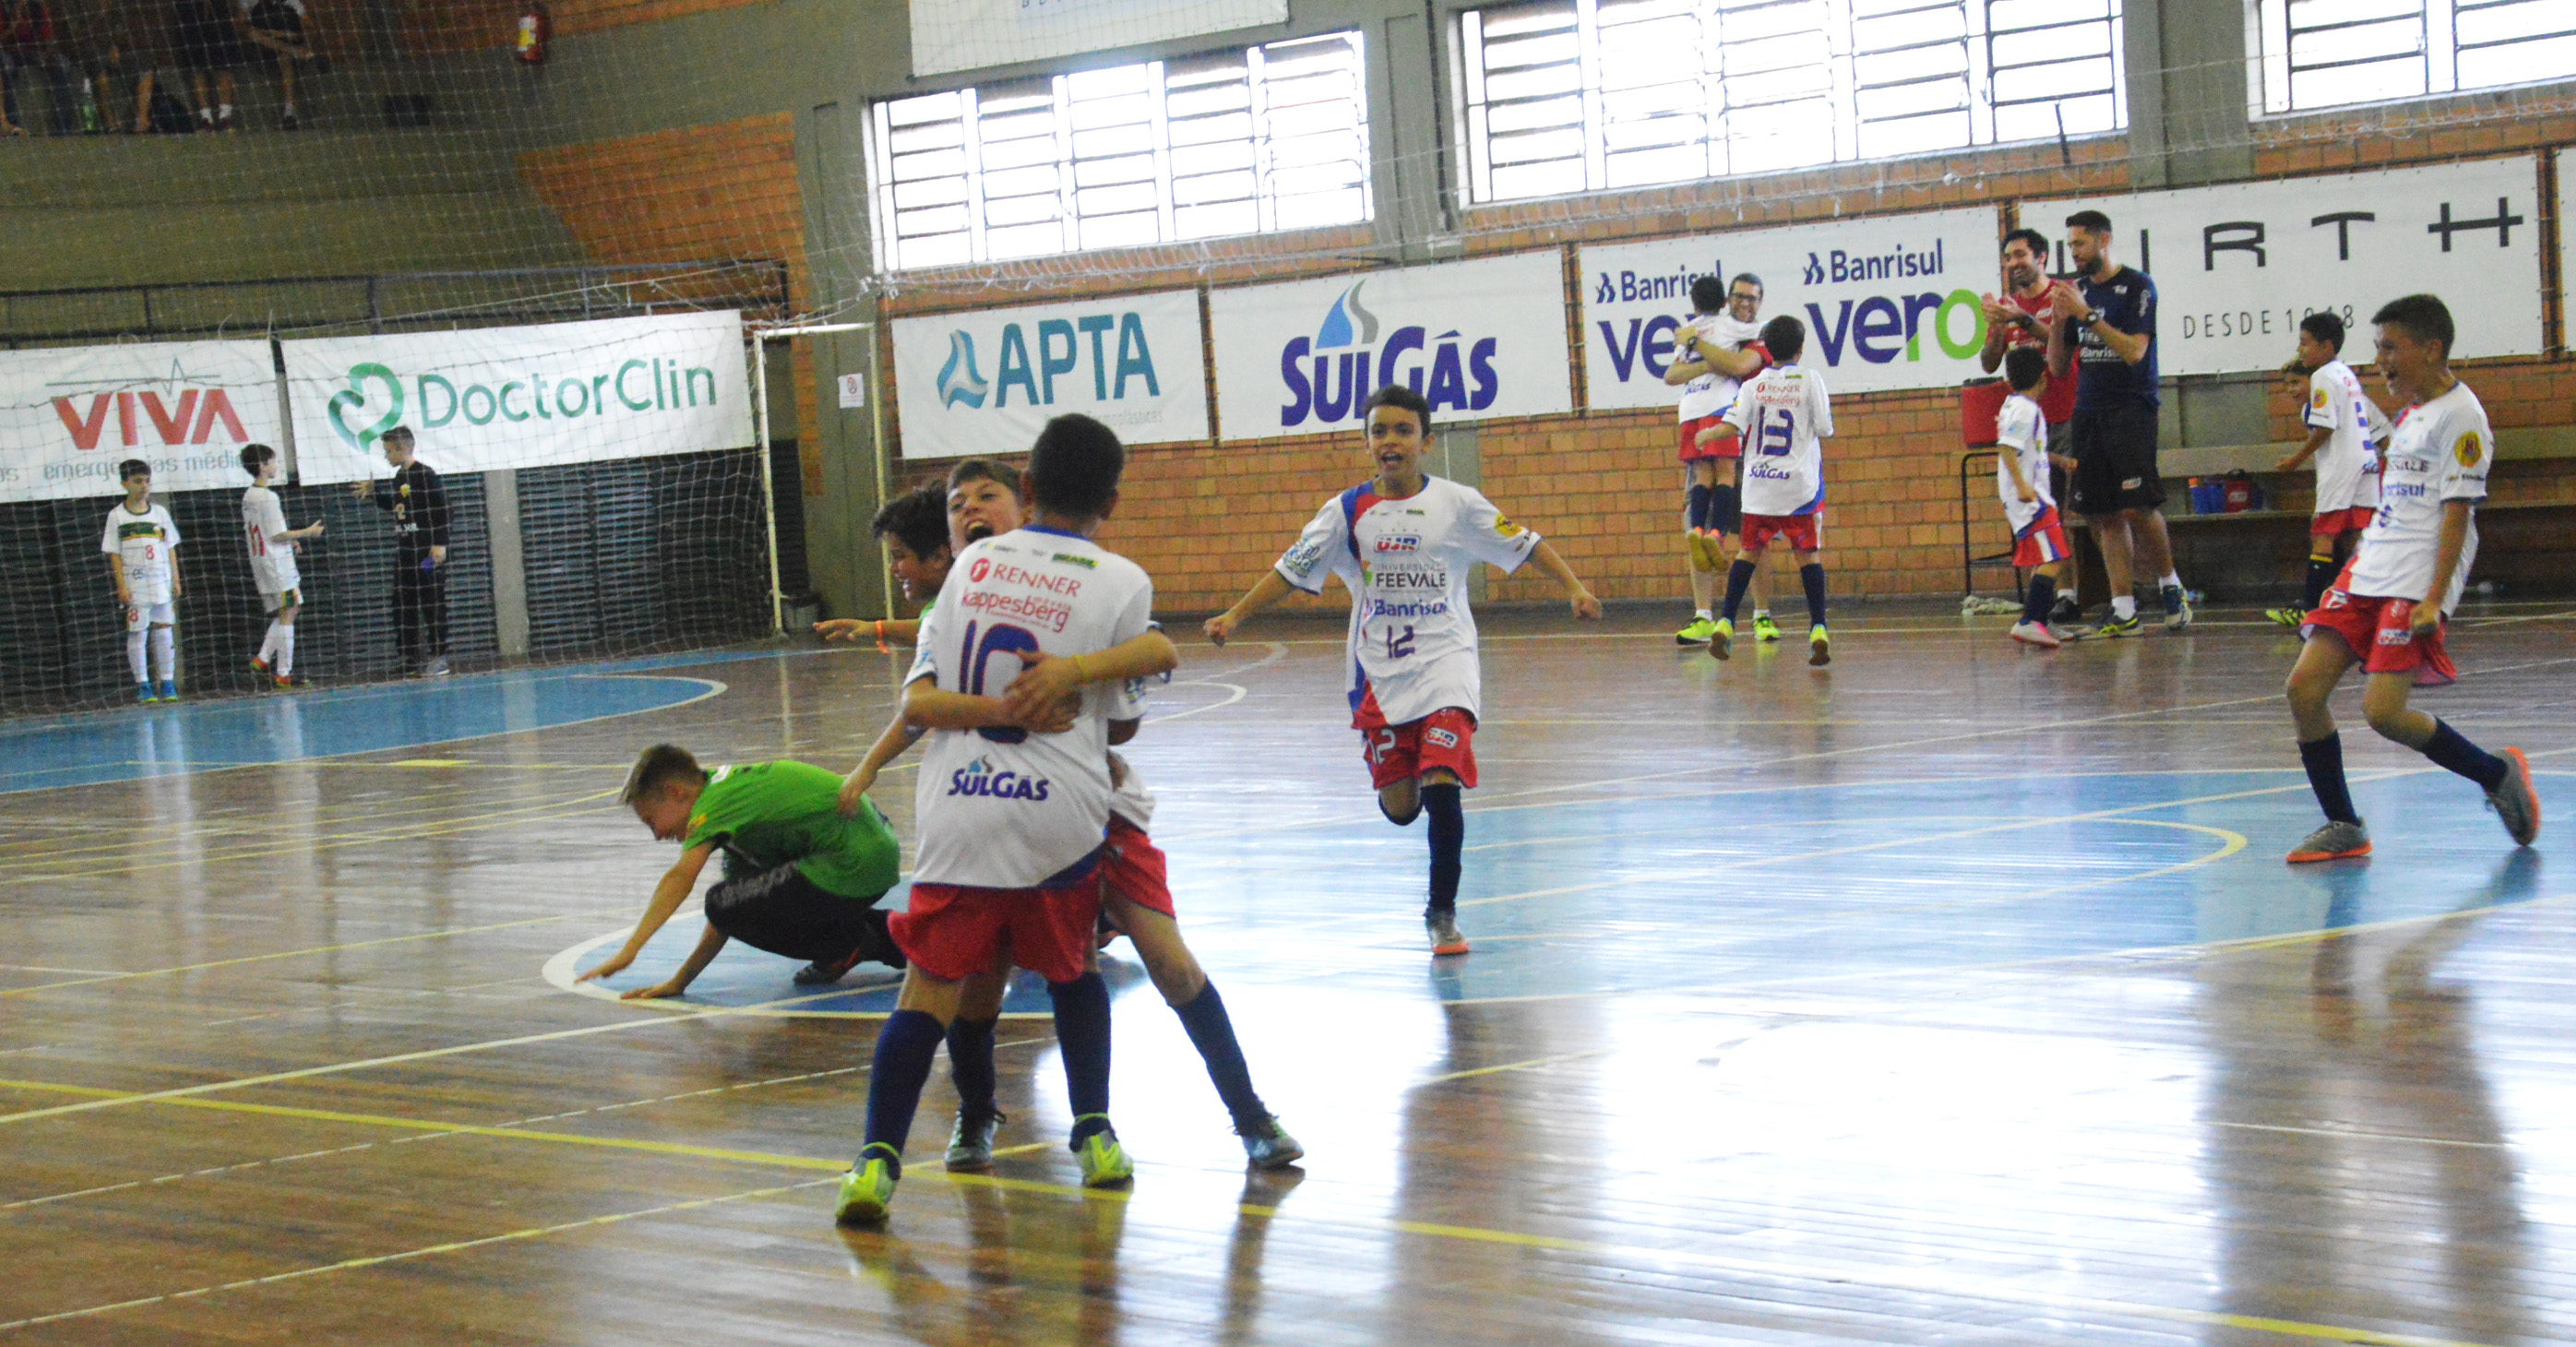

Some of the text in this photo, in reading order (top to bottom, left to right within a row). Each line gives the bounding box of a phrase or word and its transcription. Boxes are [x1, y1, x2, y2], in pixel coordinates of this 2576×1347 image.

[1620, 259, 1723, 302] Banrisl
[1830, 237, 1944, 283] Banrisul
[1803, 288, 1988, 367] vero
[2183, 309, 2272, 340] DESDE
[996, 311, 1161, 409] APTA
[417, 357, 717, 429] DoctorClin
[51, 388, 250, 450] VIVA
[1756, 405, 1795, 457] 13
[146, 544, 155, 560] 8
[992, 563, 1081, 598] RENNER
[1376, 572, 1447, 588] FEEVALE
[961, 588, 1069, 634] kappesberg
[1387, 625, 1416, 659] 12
